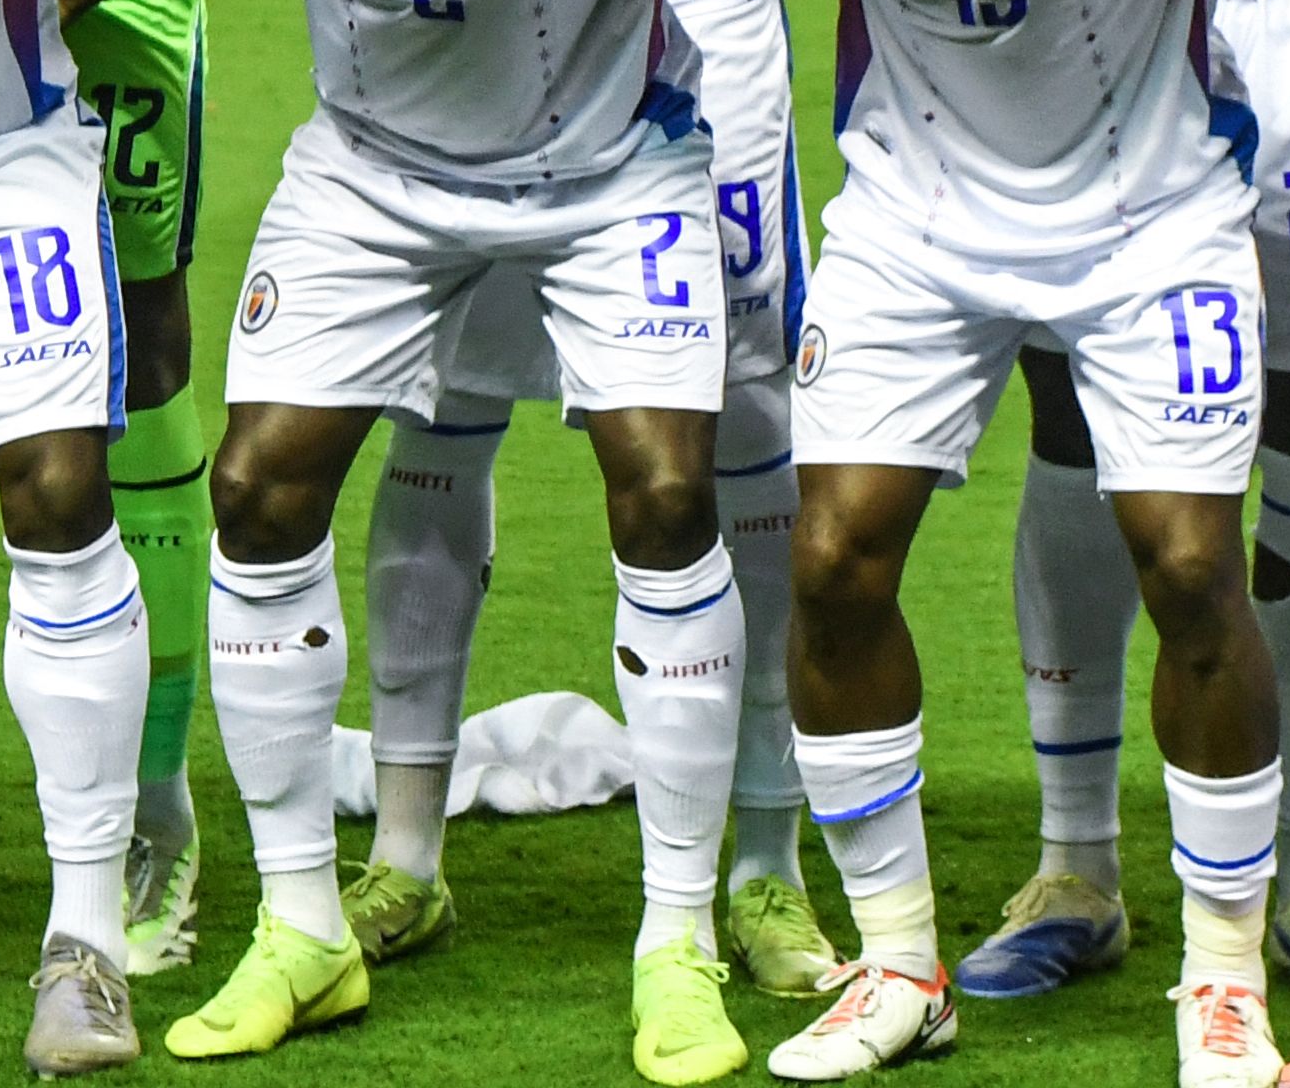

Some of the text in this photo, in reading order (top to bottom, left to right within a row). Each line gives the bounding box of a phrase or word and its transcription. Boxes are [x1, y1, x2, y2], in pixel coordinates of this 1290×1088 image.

[91, 82, 166, 188] 12
[636, 212, 689, 307] 2
[718, 180, 762, 278] 9
[614, 320, 710, 339] SAETA
[1161, 291, 1242, 394] 13
[1157, 404, 1249, 427] SAETA
